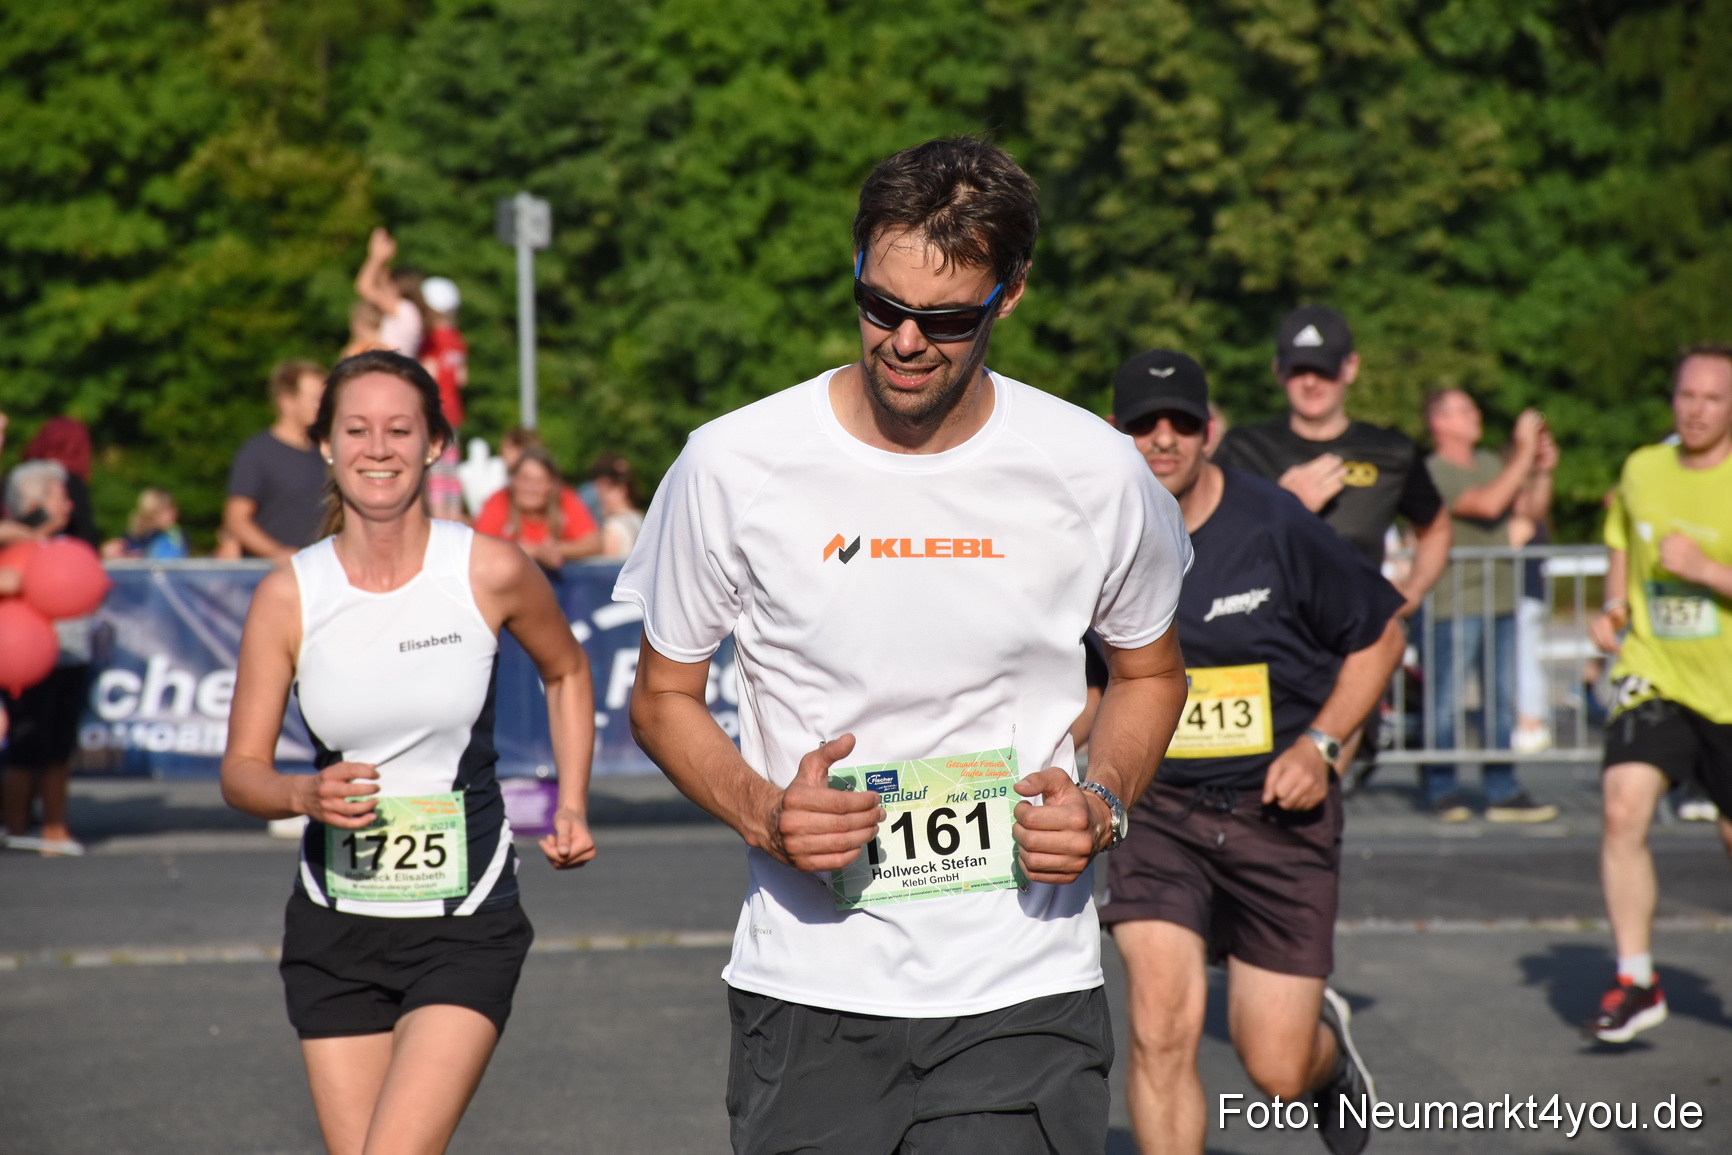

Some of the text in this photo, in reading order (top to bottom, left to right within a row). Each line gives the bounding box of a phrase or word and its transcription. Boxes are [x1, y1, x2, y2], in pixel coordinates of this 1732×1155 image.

[870, 538, 1005, 558] KLEBL
[399, 632, 462, 652] Elisabeth
[946, 760, 1005, 768] Gesunde Firmen
[961, 769, 983, 778] laufen
[879, 786, 928, 803] enlauf
[974, 786, 1007, 800] 2019
[342, 833, 447, 870] 1725
[345, 871, 446, 881] Hollweck Elisabeth
[872, 856, 987, 880] Hollweck Stefan
[902, 878, 926, 888] Klebl
[930, 873, 959, 885] GmbH
